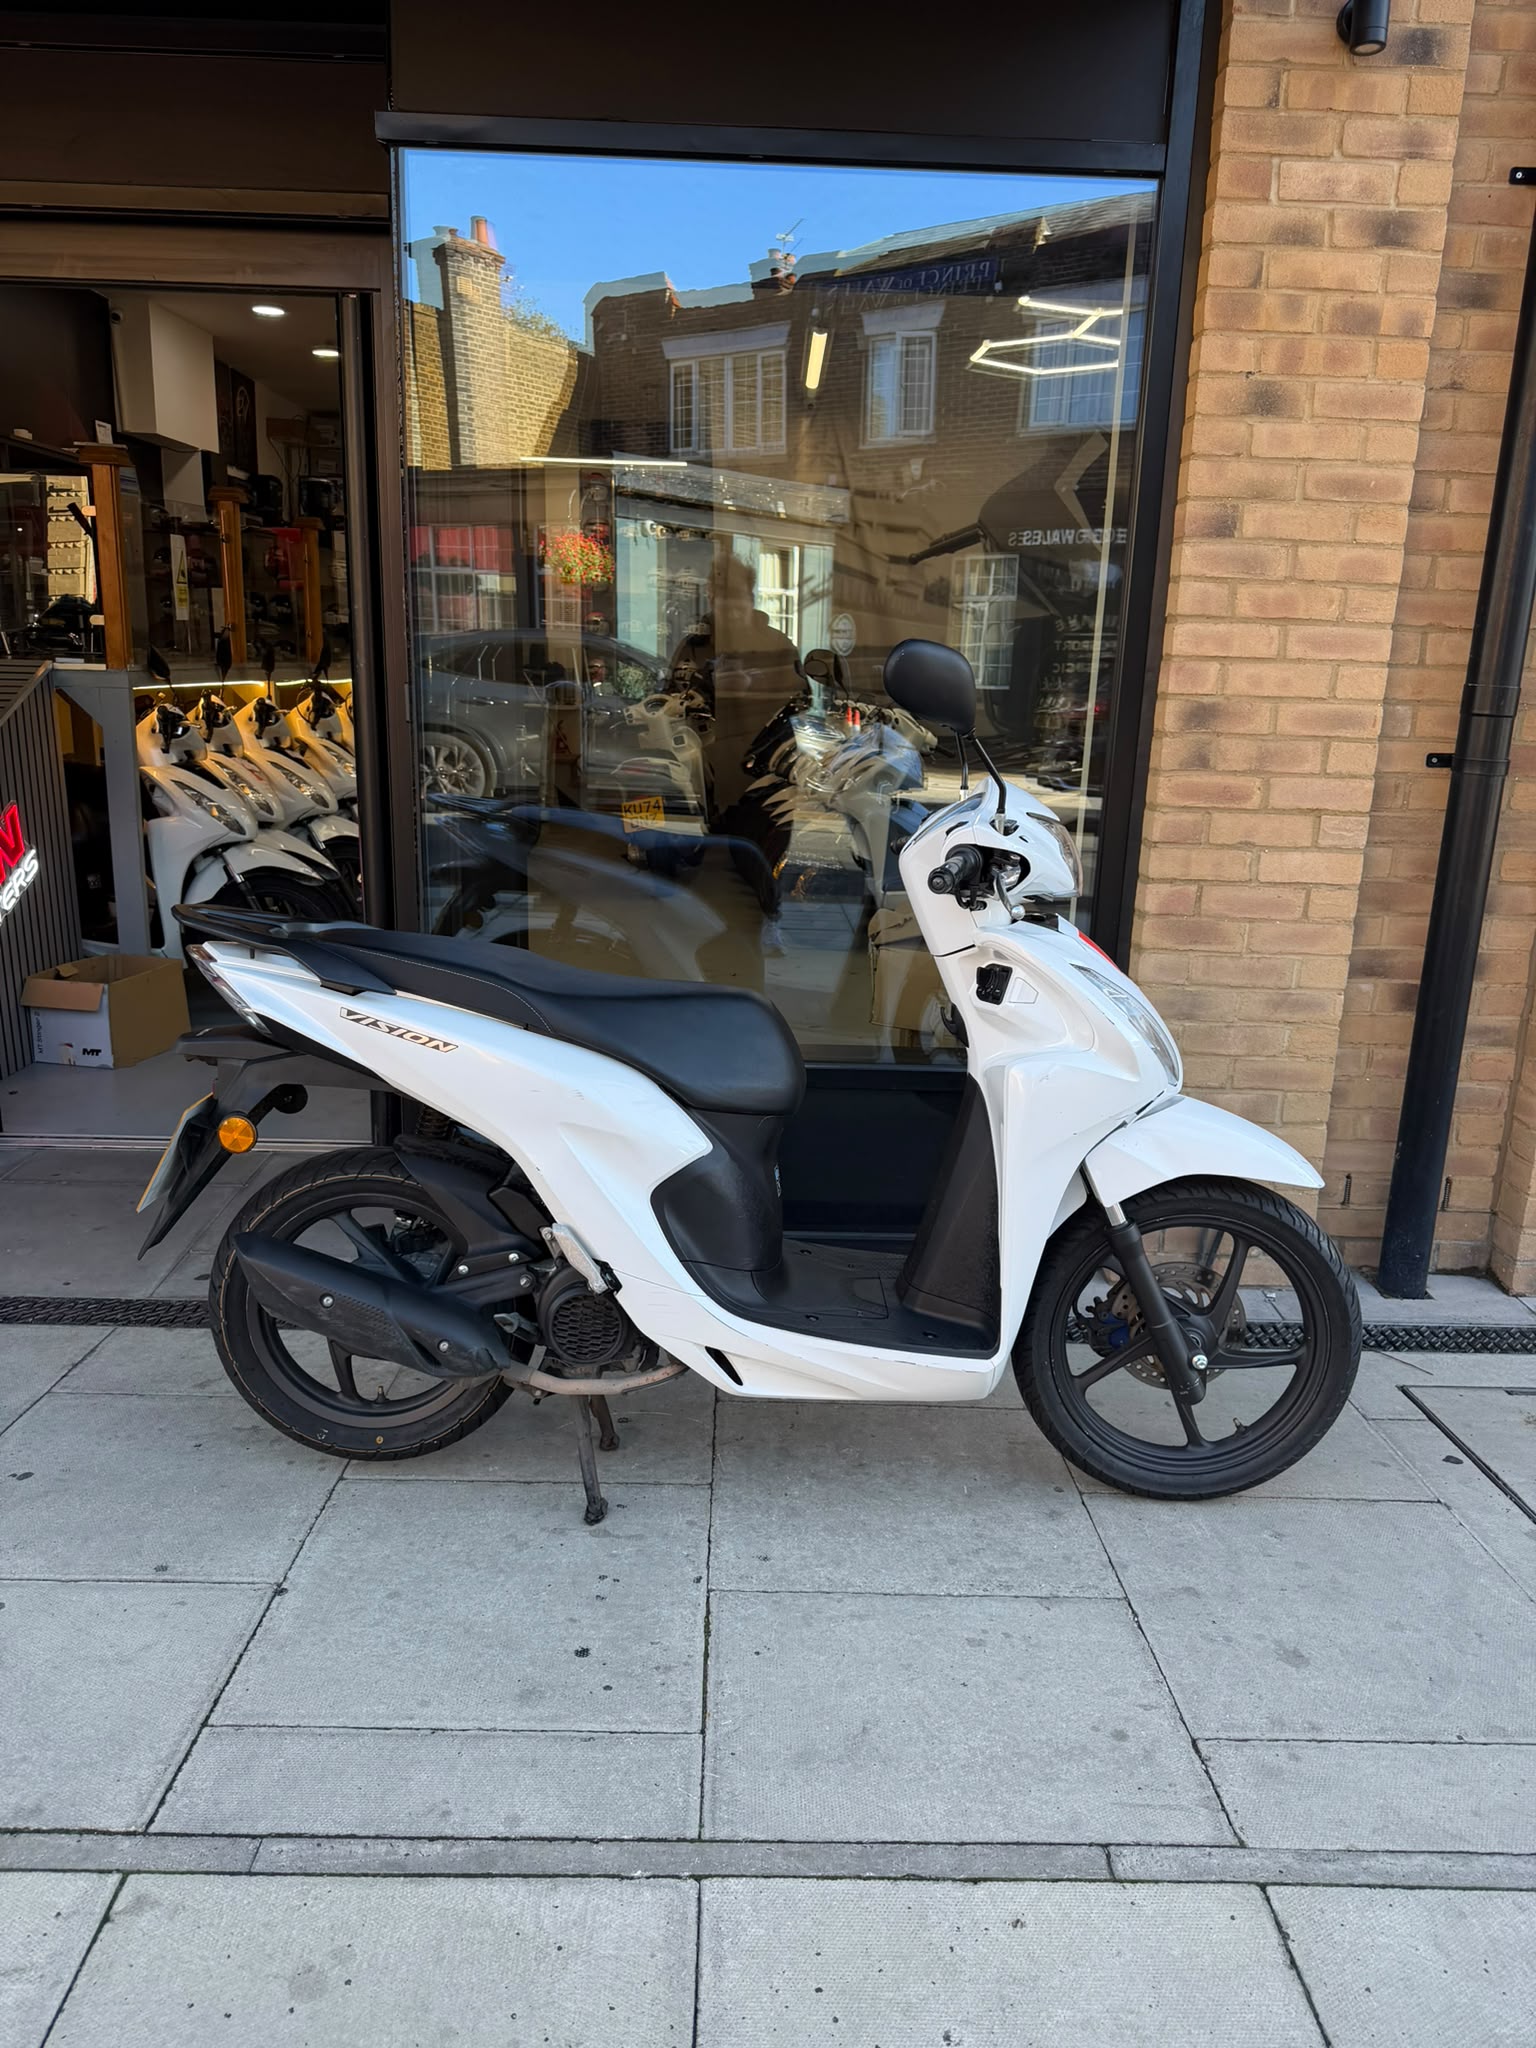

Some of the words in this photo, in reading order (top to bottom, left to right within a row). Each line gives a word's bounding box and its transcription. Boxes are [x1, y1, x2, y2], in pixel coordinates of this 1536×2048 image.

[623, 799, 662, 816] KU74
[340, 1006, 459, 1054] VISION
[82, 1048, 102, 1057] MT
